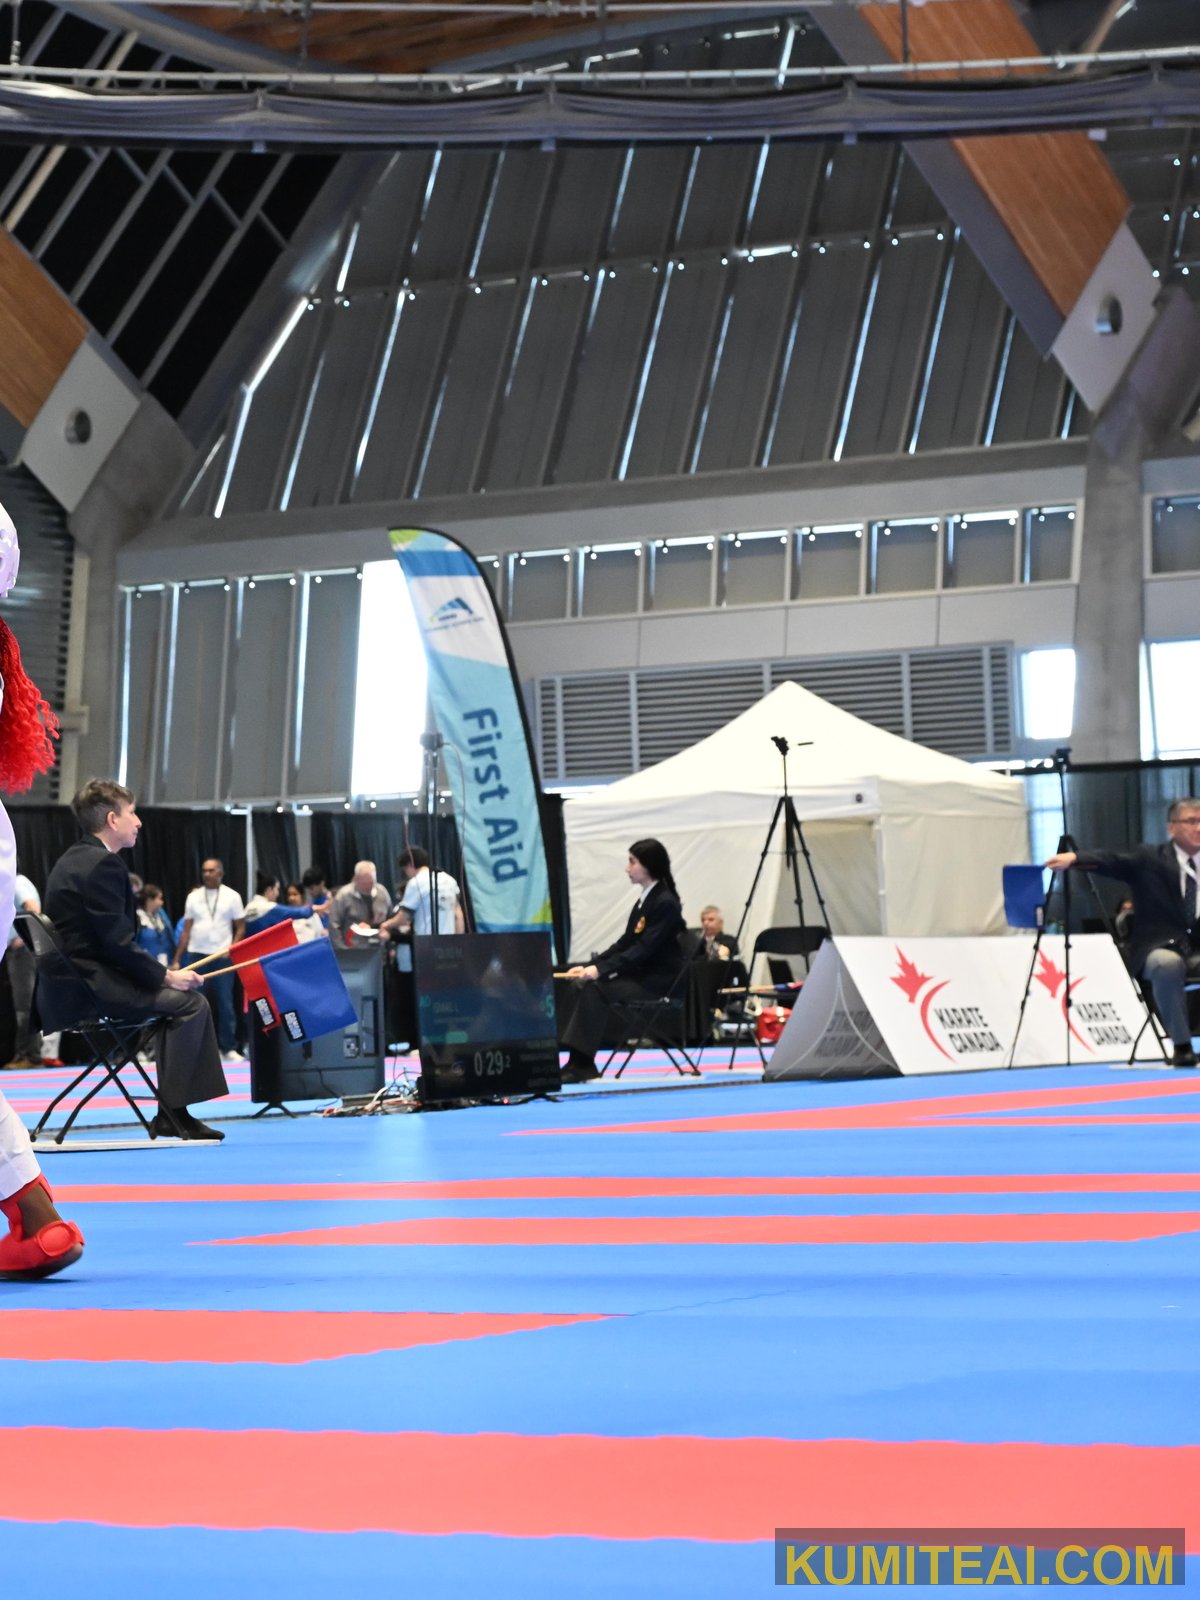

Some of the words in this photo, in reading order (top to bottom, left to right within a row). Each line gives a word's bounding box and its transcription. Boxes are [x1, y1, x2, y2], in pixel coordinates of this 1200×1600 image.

[462, 707, 510, 805] First
[483, 817, 529, 883] Aid
[934, 1006, 988, 1029] KARATE
[1074, 1002, 1121, 1023] KARATE
[948, 1031, 1004, 1054] CANADA
[1087, 1025, 1134, 1046] CANADA
